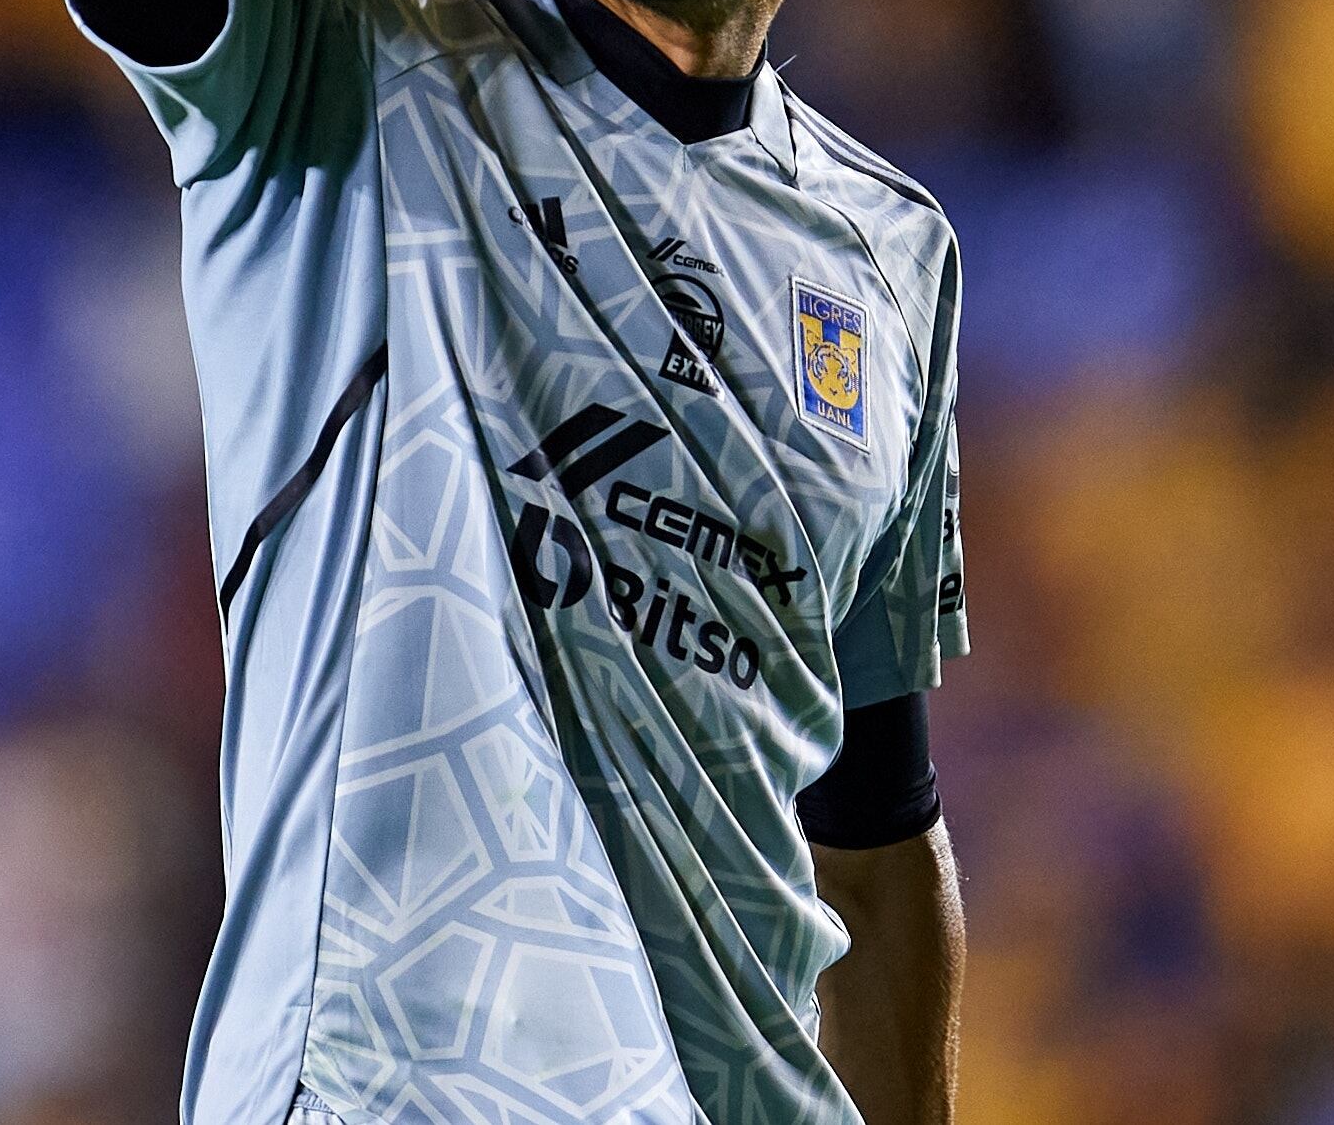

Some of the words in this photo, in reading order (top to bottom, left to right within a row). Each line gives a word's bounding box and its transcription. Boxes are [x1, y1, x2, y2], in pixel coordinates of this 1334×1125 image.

[801, 292, 862, 336] TIGRES
[816, 400, 854, 431] UANL
[605, 480, 808, 607] CEMEX
[602, 561, 760, 691] Bitso
